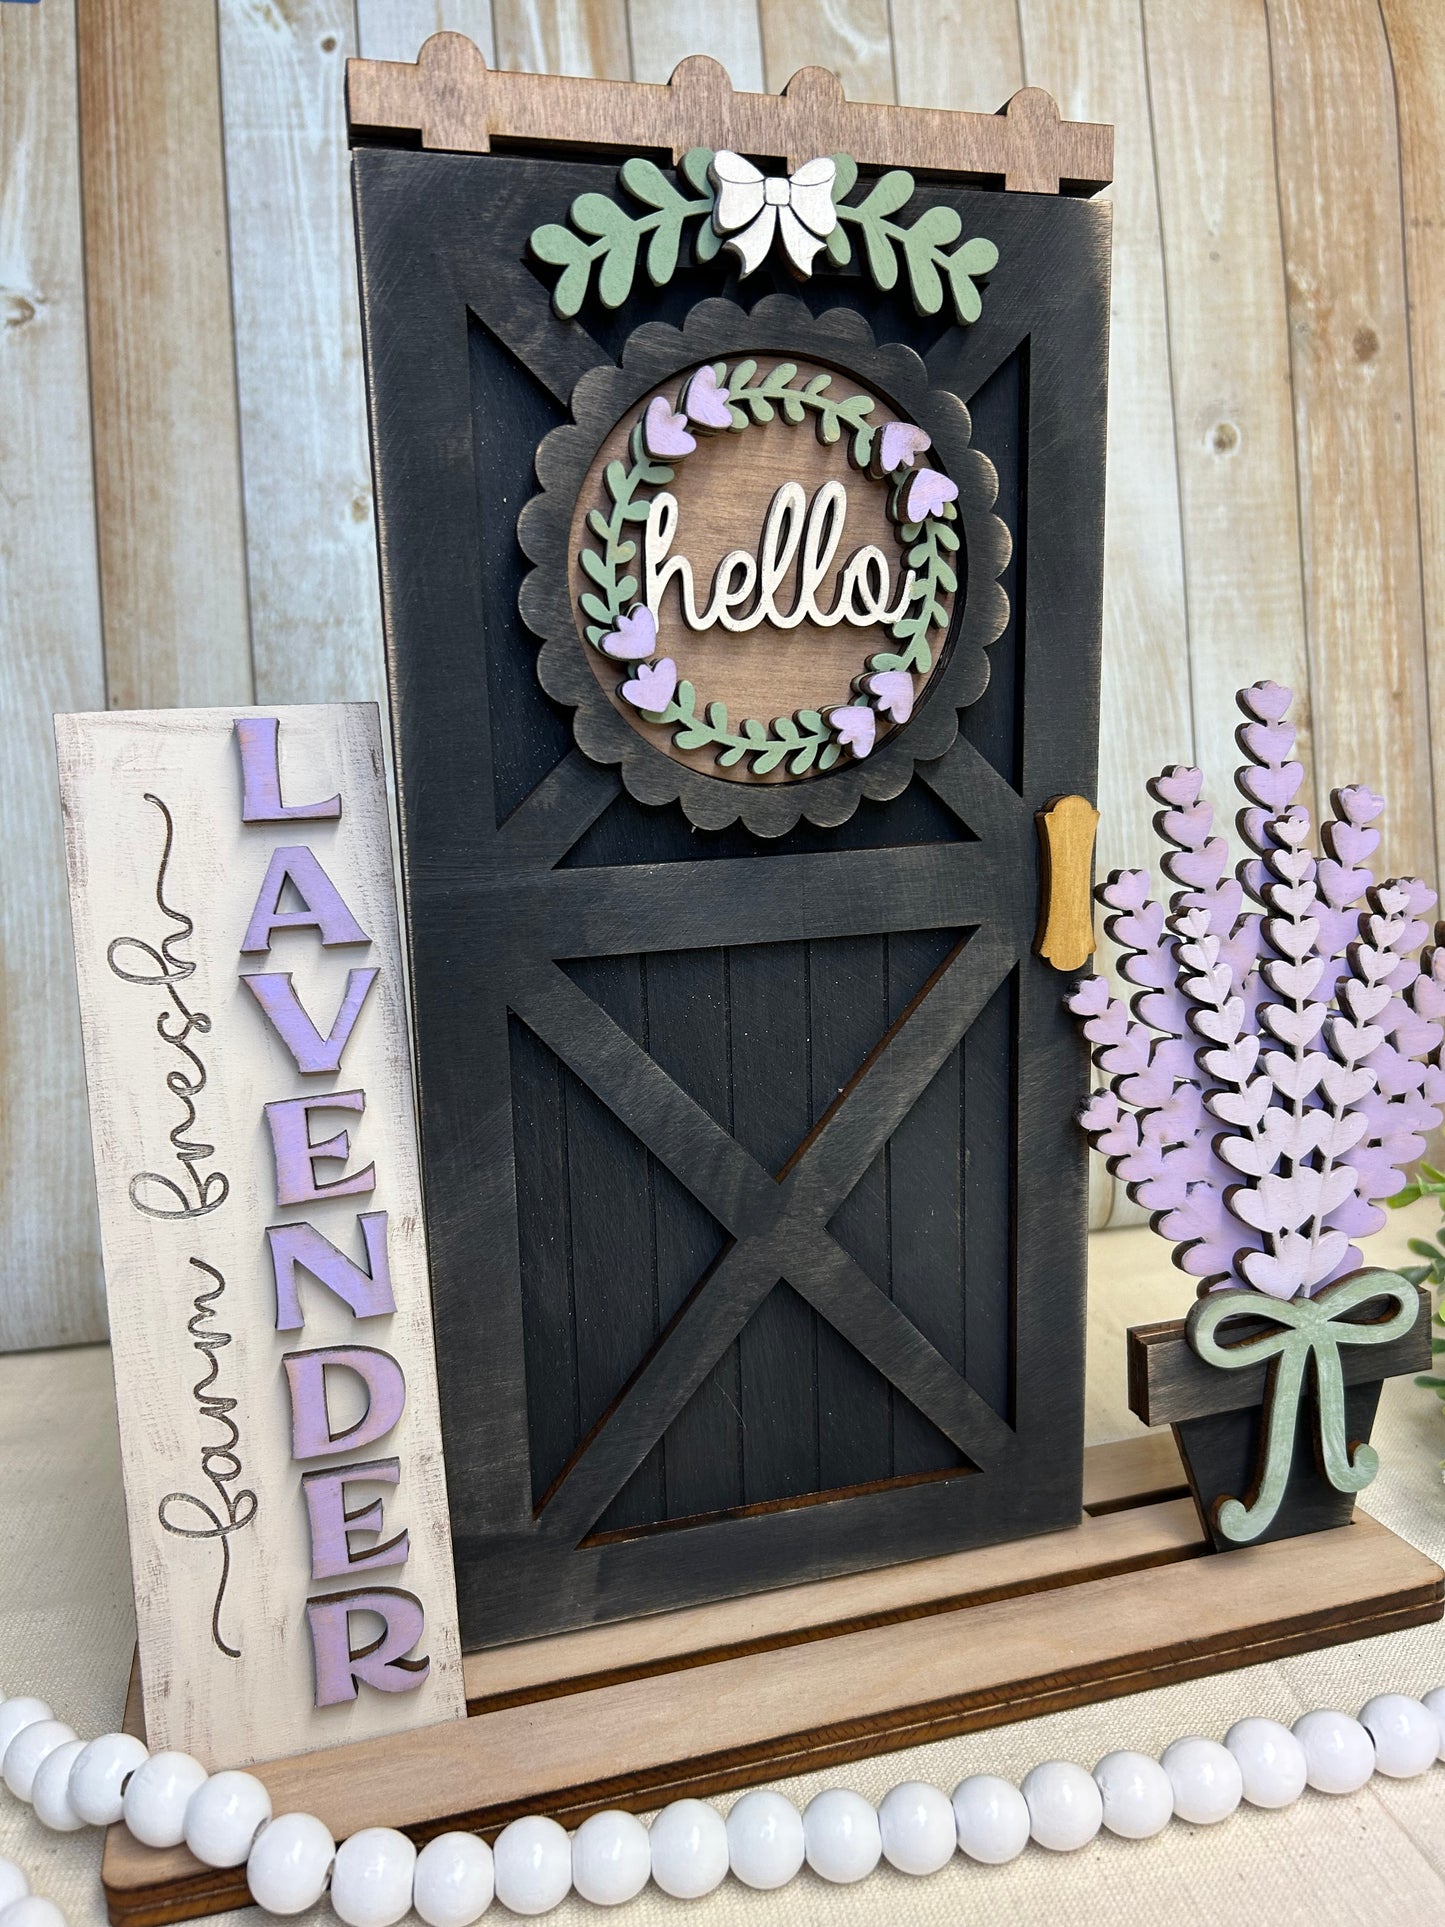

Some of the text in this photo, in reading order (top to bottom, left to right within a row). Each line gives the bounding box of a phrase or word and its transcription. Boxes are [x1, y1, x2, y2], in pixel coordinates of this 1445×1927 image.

[643, 481, 916, 632] hello
[107, 792, 258, 1659] farm fresh
[232, 717, 431, 1709] LAVENDER
